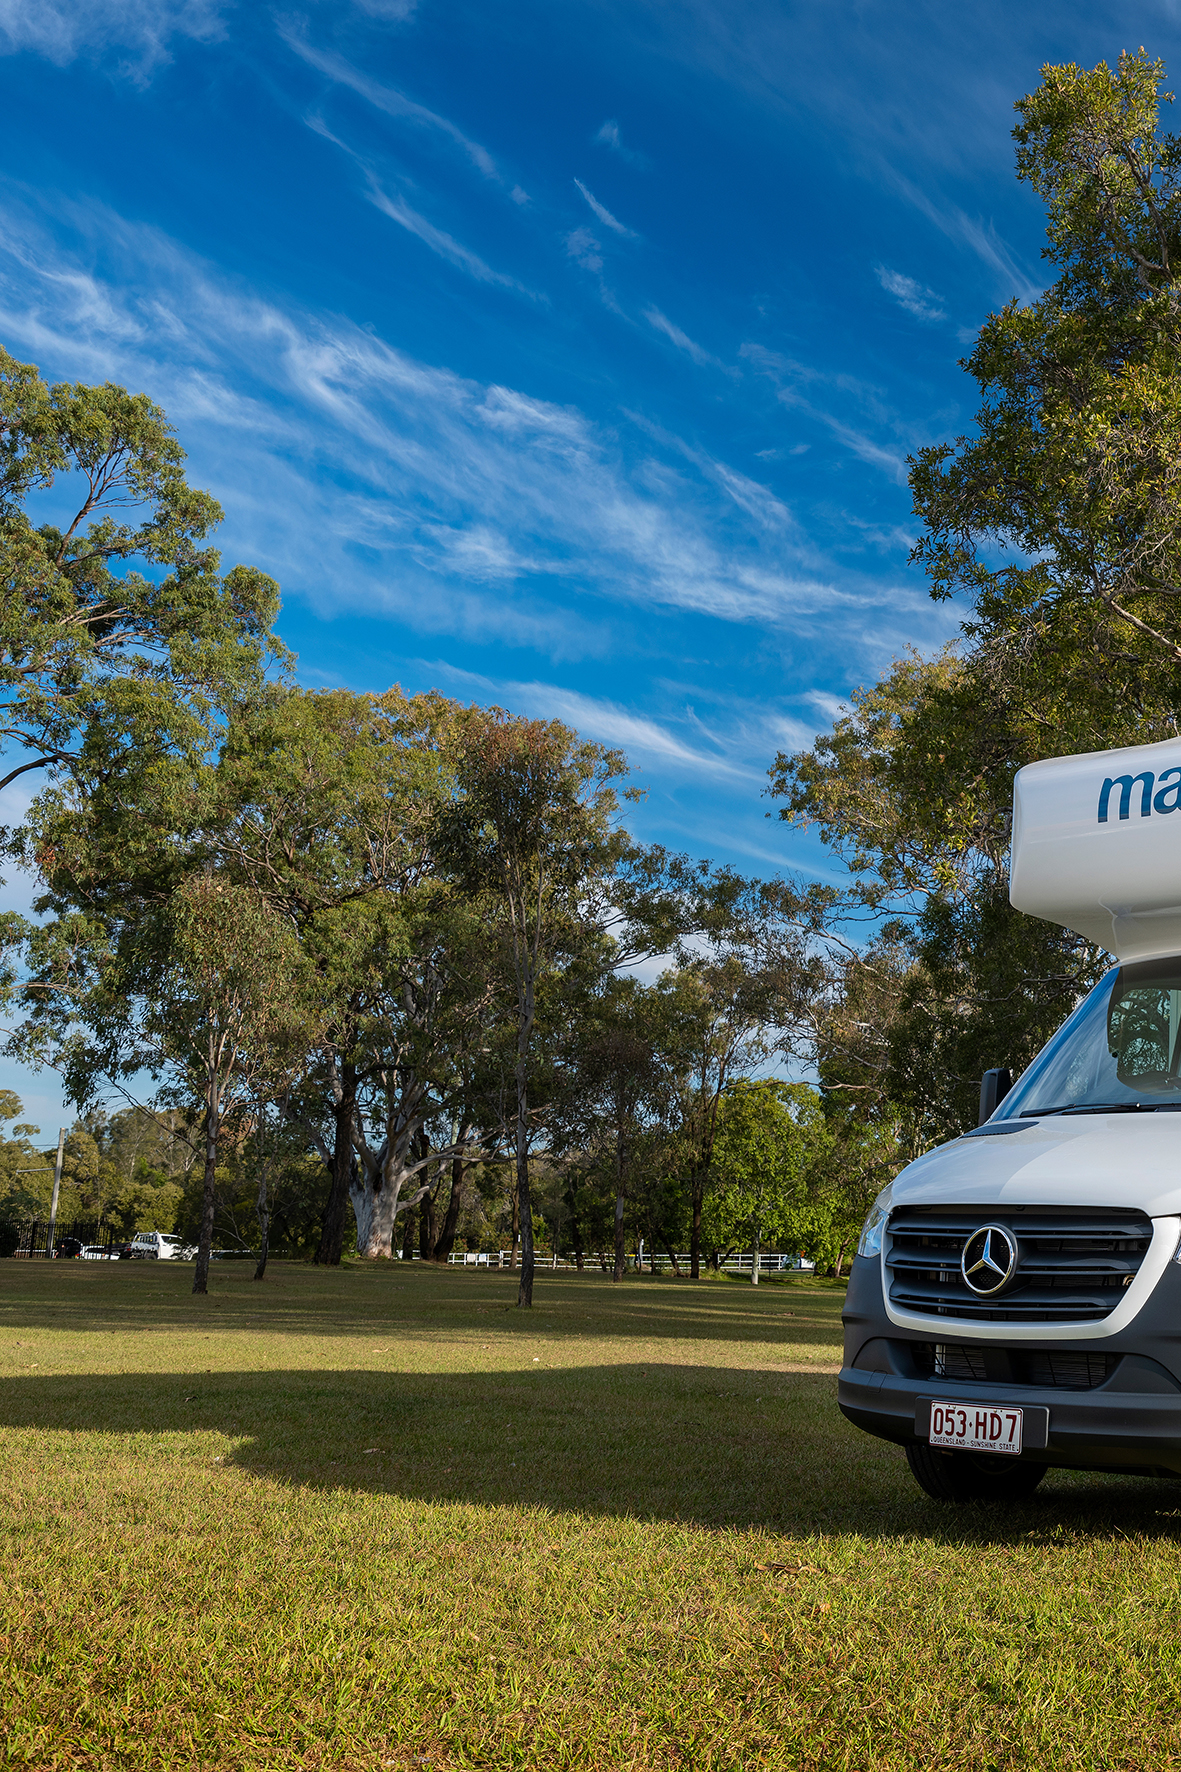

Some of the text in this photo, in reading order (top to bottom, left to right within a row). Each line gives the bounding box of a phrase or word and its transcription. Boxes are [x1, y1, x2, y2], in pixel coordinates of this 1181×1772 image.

[933, 1436, 966, 1446] QUEENSLAND
[970, 1440, 997, 1449] SUNSHINE
[998, 1443, 1016, 1451] STATE
